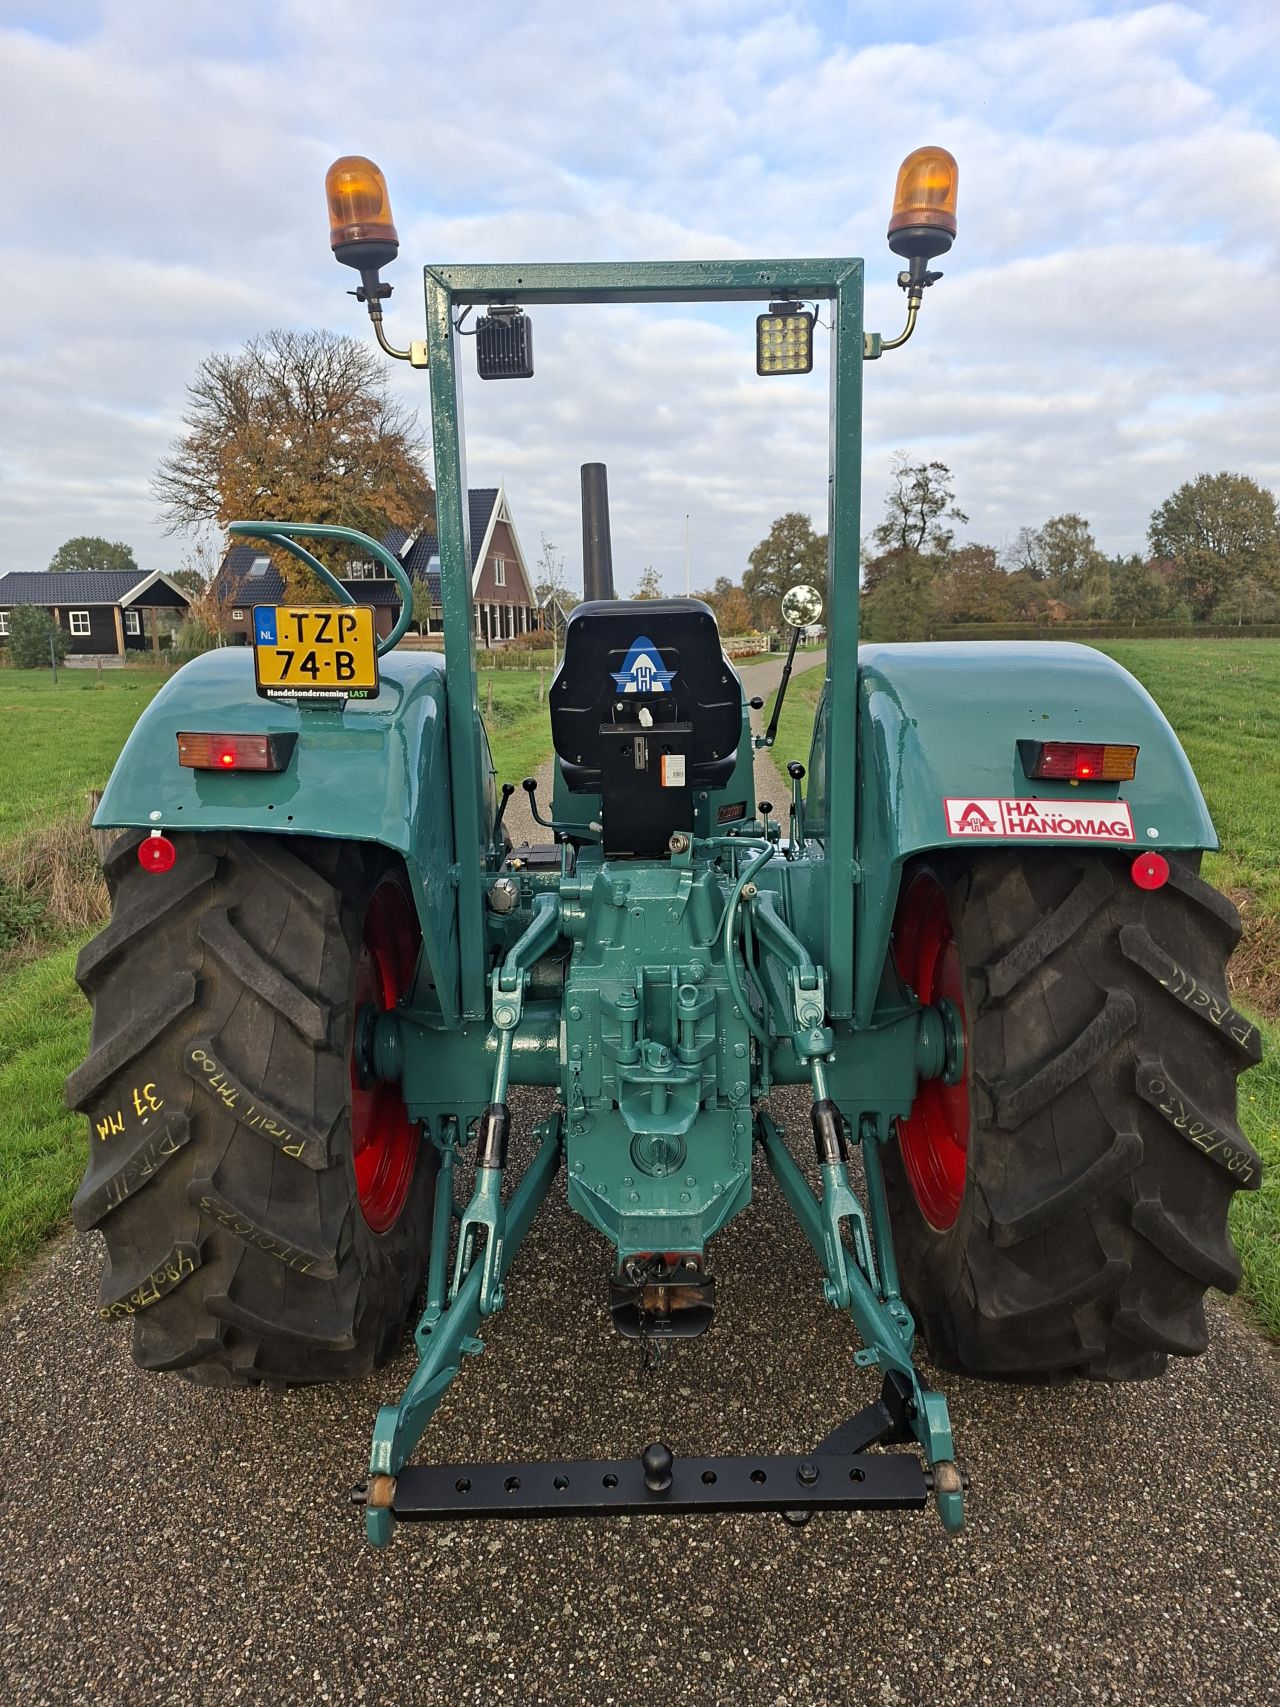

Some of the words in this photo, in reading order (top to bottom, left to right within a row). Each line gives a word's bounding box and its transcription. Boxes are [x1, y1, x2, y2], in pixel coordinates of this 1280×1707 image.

[260, 631, 274, 640] NL
[290, 614, 357, 643] TZP
[276, 651, 355, 680] 74-B
[267, 689, 348, 699] Handelsonderneming
[350, 690, 368, 698] LAST
[1009, 818, 1130, 837] HANOMAG
[191, 1050, 240, 1109] TM700
[132, 1083, 163, 1117] 37
[96, 1110, 126, 1141] MM
[243, 1105, 307, 1158] Pirelli
